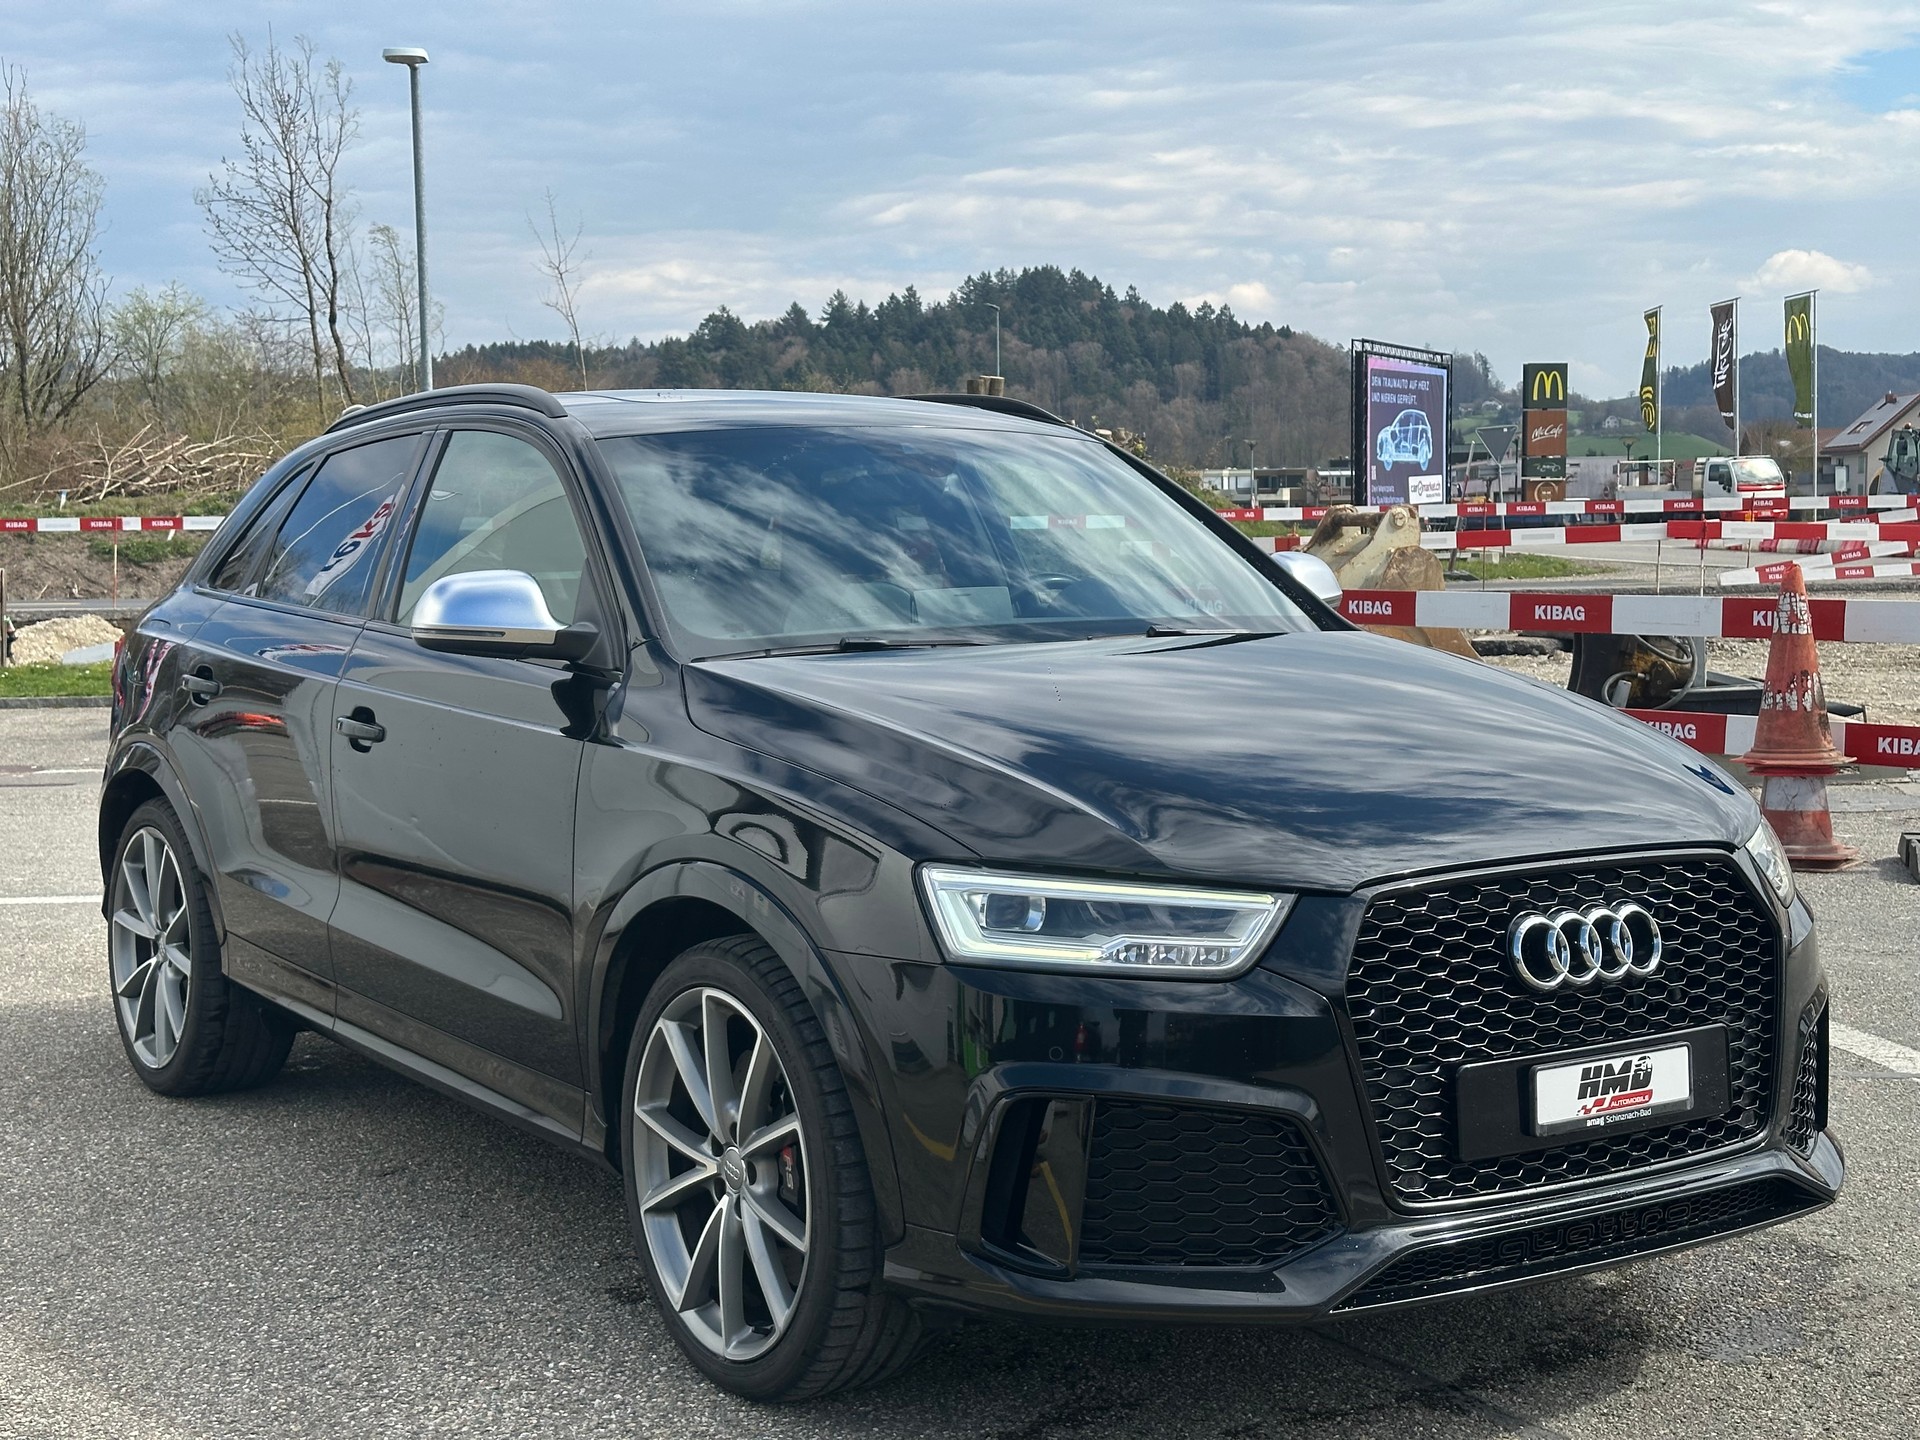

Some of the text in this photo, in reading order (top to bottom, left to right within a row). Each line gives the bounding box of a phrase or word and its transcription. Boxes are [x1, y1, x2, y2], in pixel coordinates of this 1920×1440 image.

[1371, 376, 1382, 387] DEIN
[1409, 379, 1418, 390] AUF
[1418, 380, 1430, 391] HERZ
[1371, 391, 1380, 403] UND
[1594, 503, 1616, 511] KIBAG
[1753, 499, 1774, 507] KIBAG
[1838, 498, 1859, 506] KIBAG
[90, 520, 113, 528] KIBAG
[151, 519, 174, 527] KIBAG
[1841, 550, 1862, 560] KIBAG
[1844, 568, 1865, 576] KIBAG
[1348, 600, 1392, 615] KIBAG
[1534, 604, 1585, 621] KIBAG
[1877, 736, 1920, 756] KIBA
[1610, 1095, 1650, 1107] AUTOMOBILE
[1586, 1108, 1652, 1127] amag Schinznach-Bad
[1500, 1202, 1692, 1260] quattro
